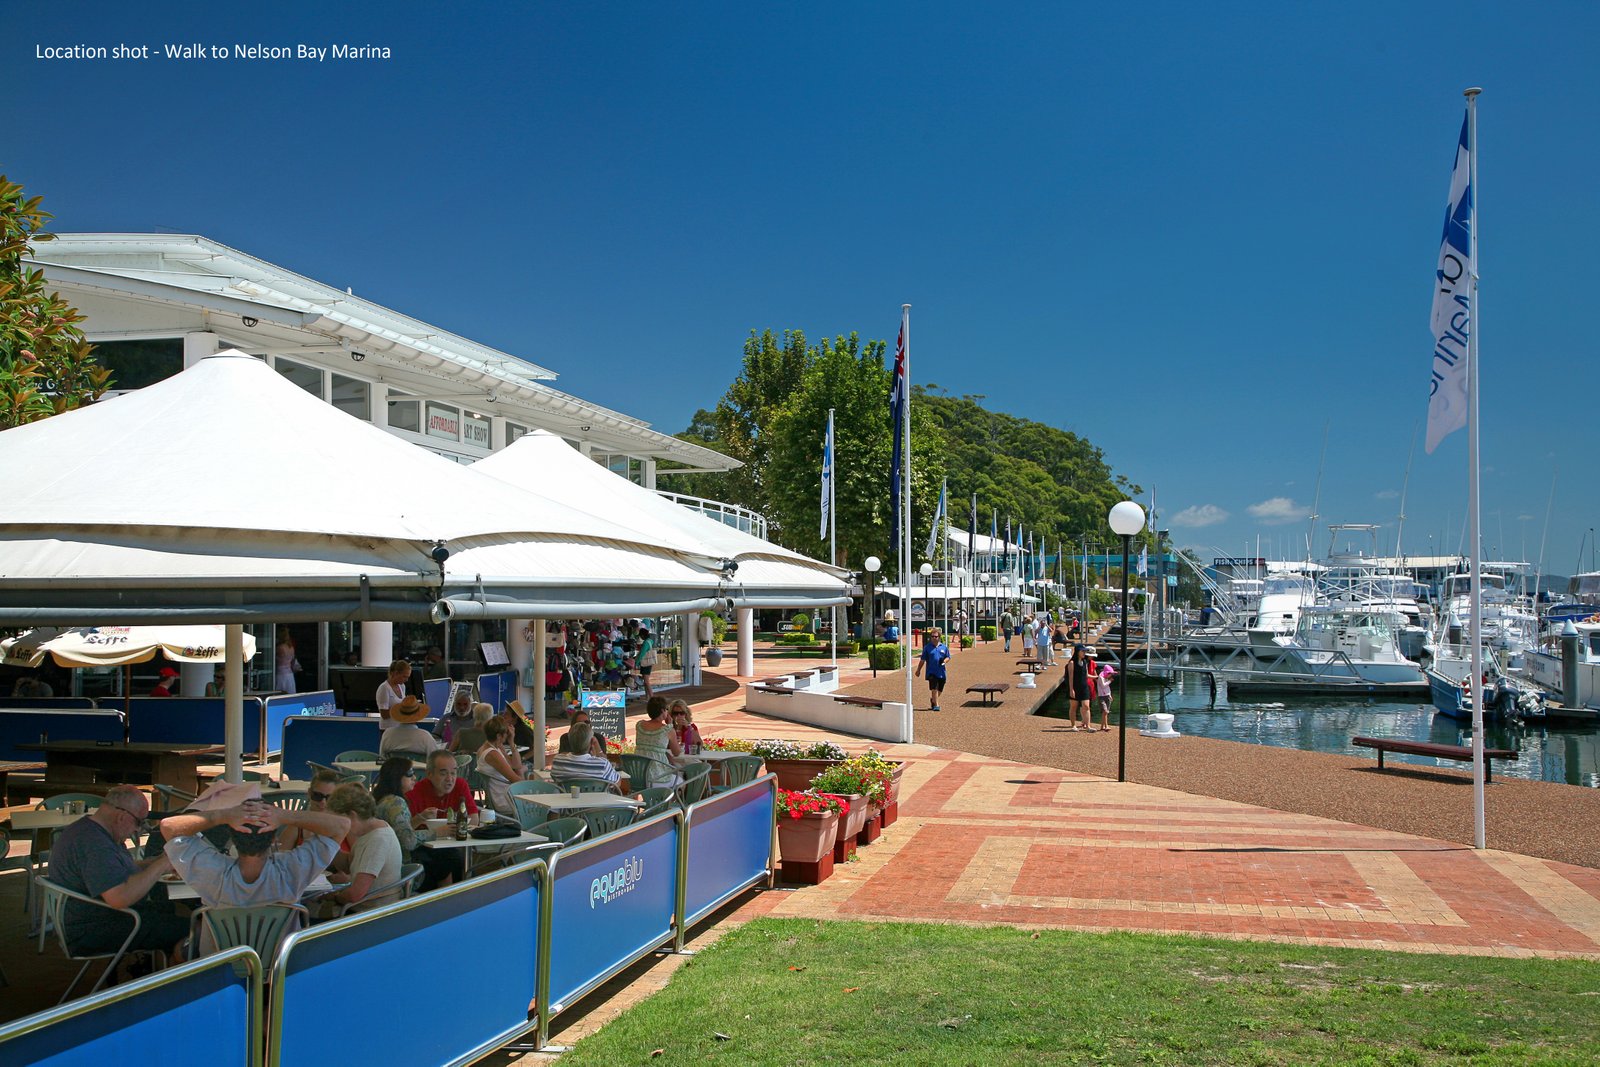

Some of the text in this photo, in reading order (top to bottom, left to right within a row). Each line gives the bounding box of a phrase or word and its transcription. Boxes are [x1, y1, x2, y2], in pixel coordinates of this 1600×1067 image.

[464, 423, 473, 439] ART
[474, 425, 488, 442] SHOW
[83, 635, 128, 646] Leffe
[195, 645, 219, 658] Leffe
[591, 723, 618, 733] ewellery
